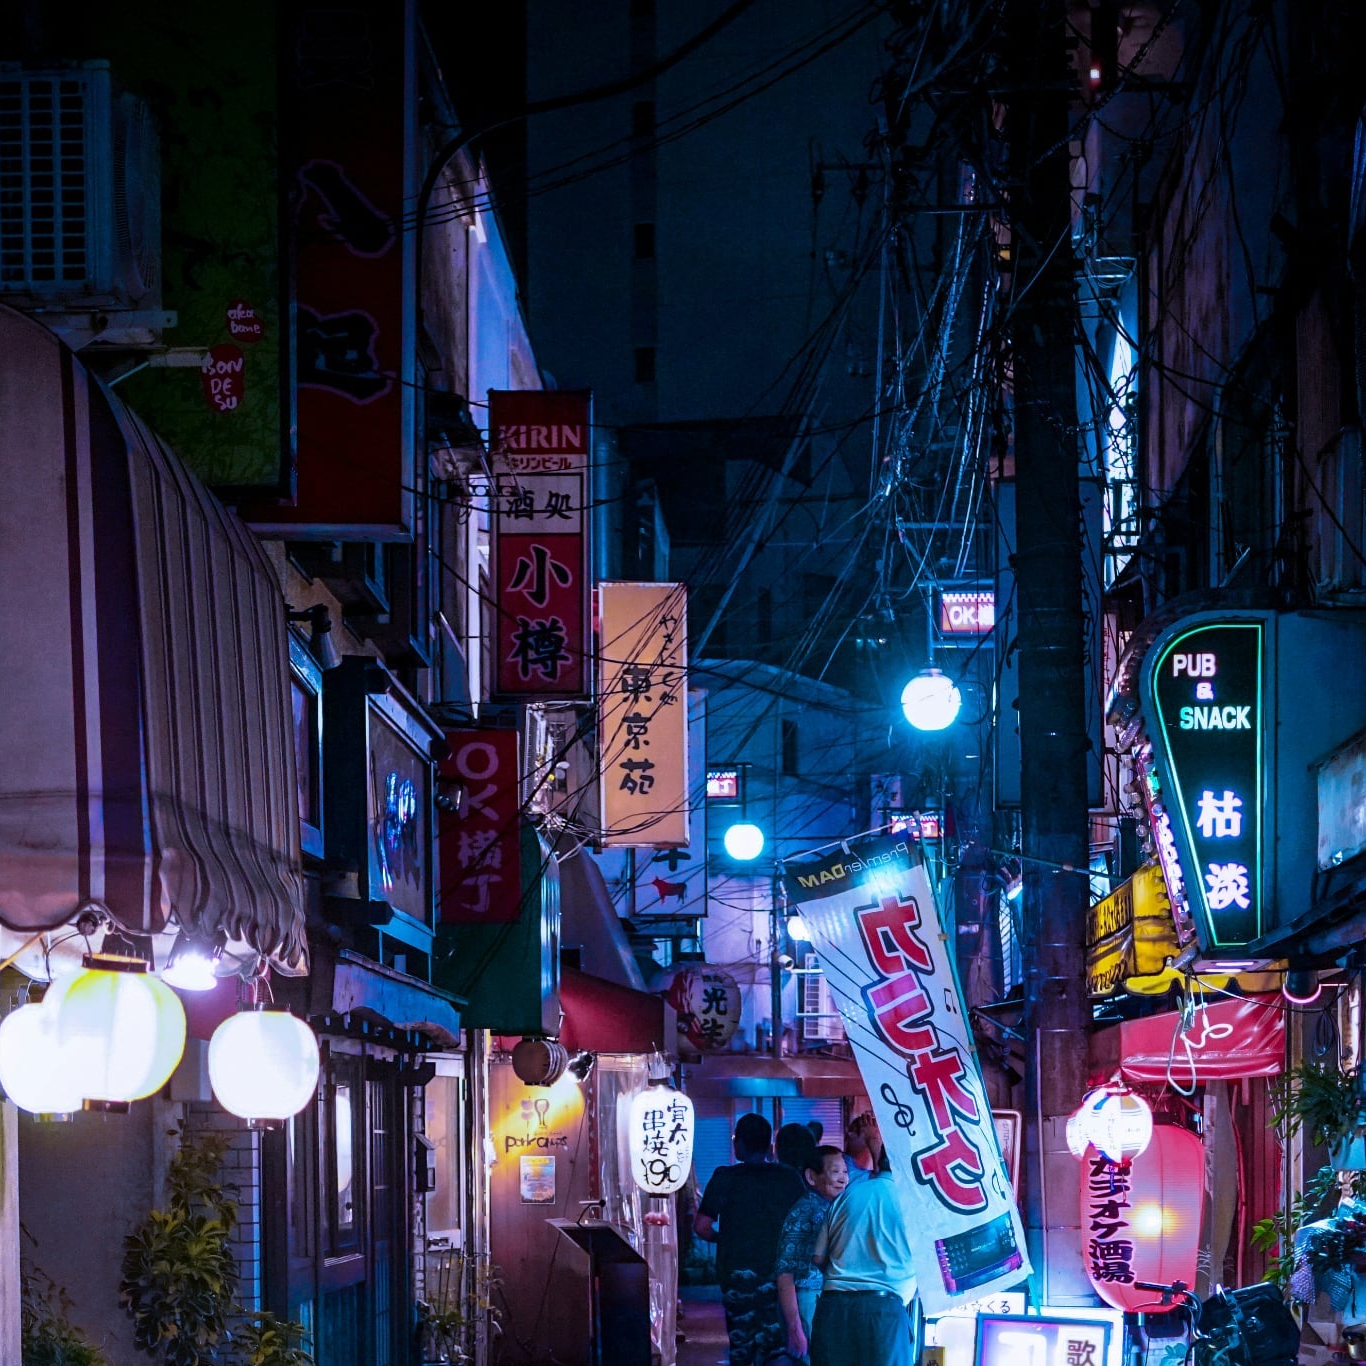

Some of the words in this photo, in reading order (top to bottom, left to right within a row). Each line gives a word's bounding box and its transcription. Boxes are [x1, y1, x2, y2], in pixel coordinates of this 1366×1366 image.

[210, 379, 233, 396] DE
[215, 395, 238, 412] SU
[498, 424, 582, 449] KIRIN
[510, 457, 572, 470] キリンビール
[506, 486, 574, 520] 酒処
[506, 543, 573, 682] 小樽
[1173, 653, 1217, 677] PUB
[1196, 683, 1214, 700] &
[619, 664, 656, 796] 東京苑
[1180, 706, 1252, 730] SNACK
[456, 741, 503, 912] OK横丁
[1196, 790, 1251, 911] 枯淡
